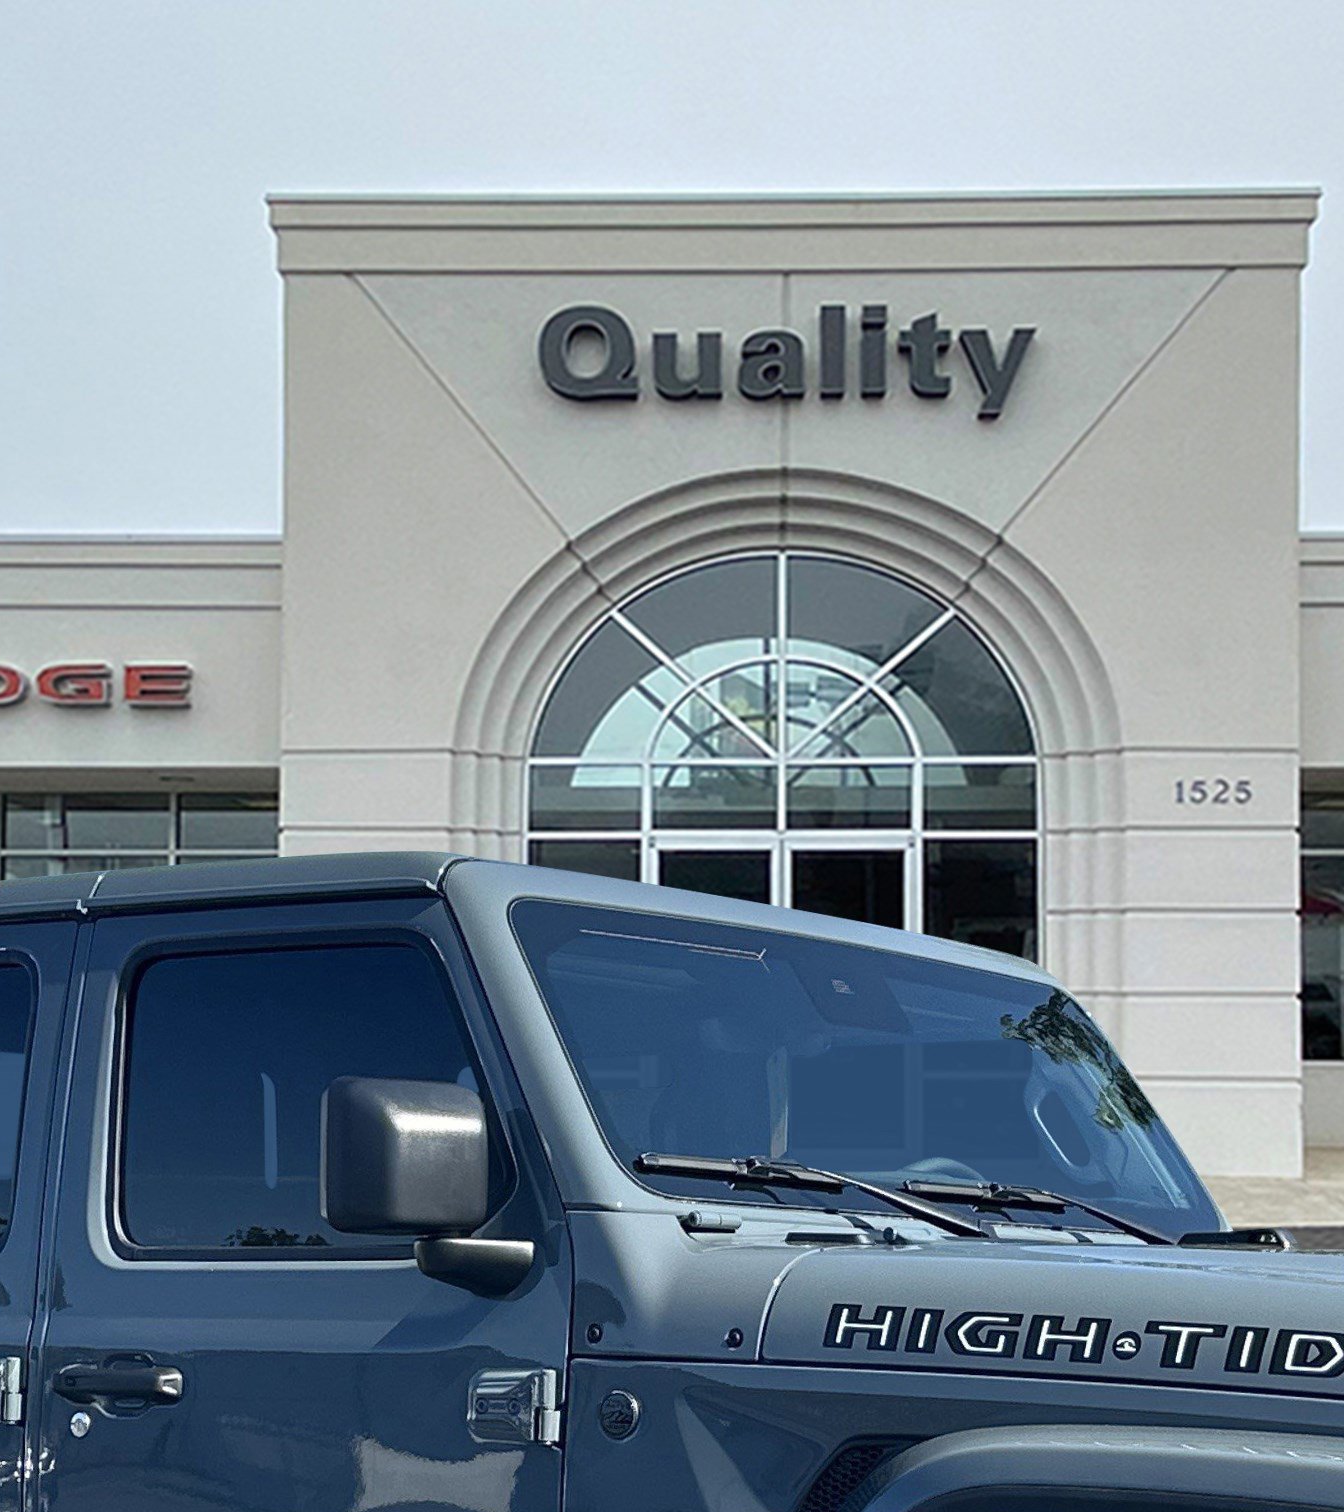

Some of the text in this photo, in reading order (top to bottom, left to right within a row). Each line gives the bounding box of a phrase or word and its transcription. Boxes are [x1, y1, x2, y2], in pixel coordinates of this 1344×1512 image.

[537, 304, 1038, 420] Quality
[1175, 778, 1253, 804] 1525
[822, 1303, 1113, 1364] HIGH
